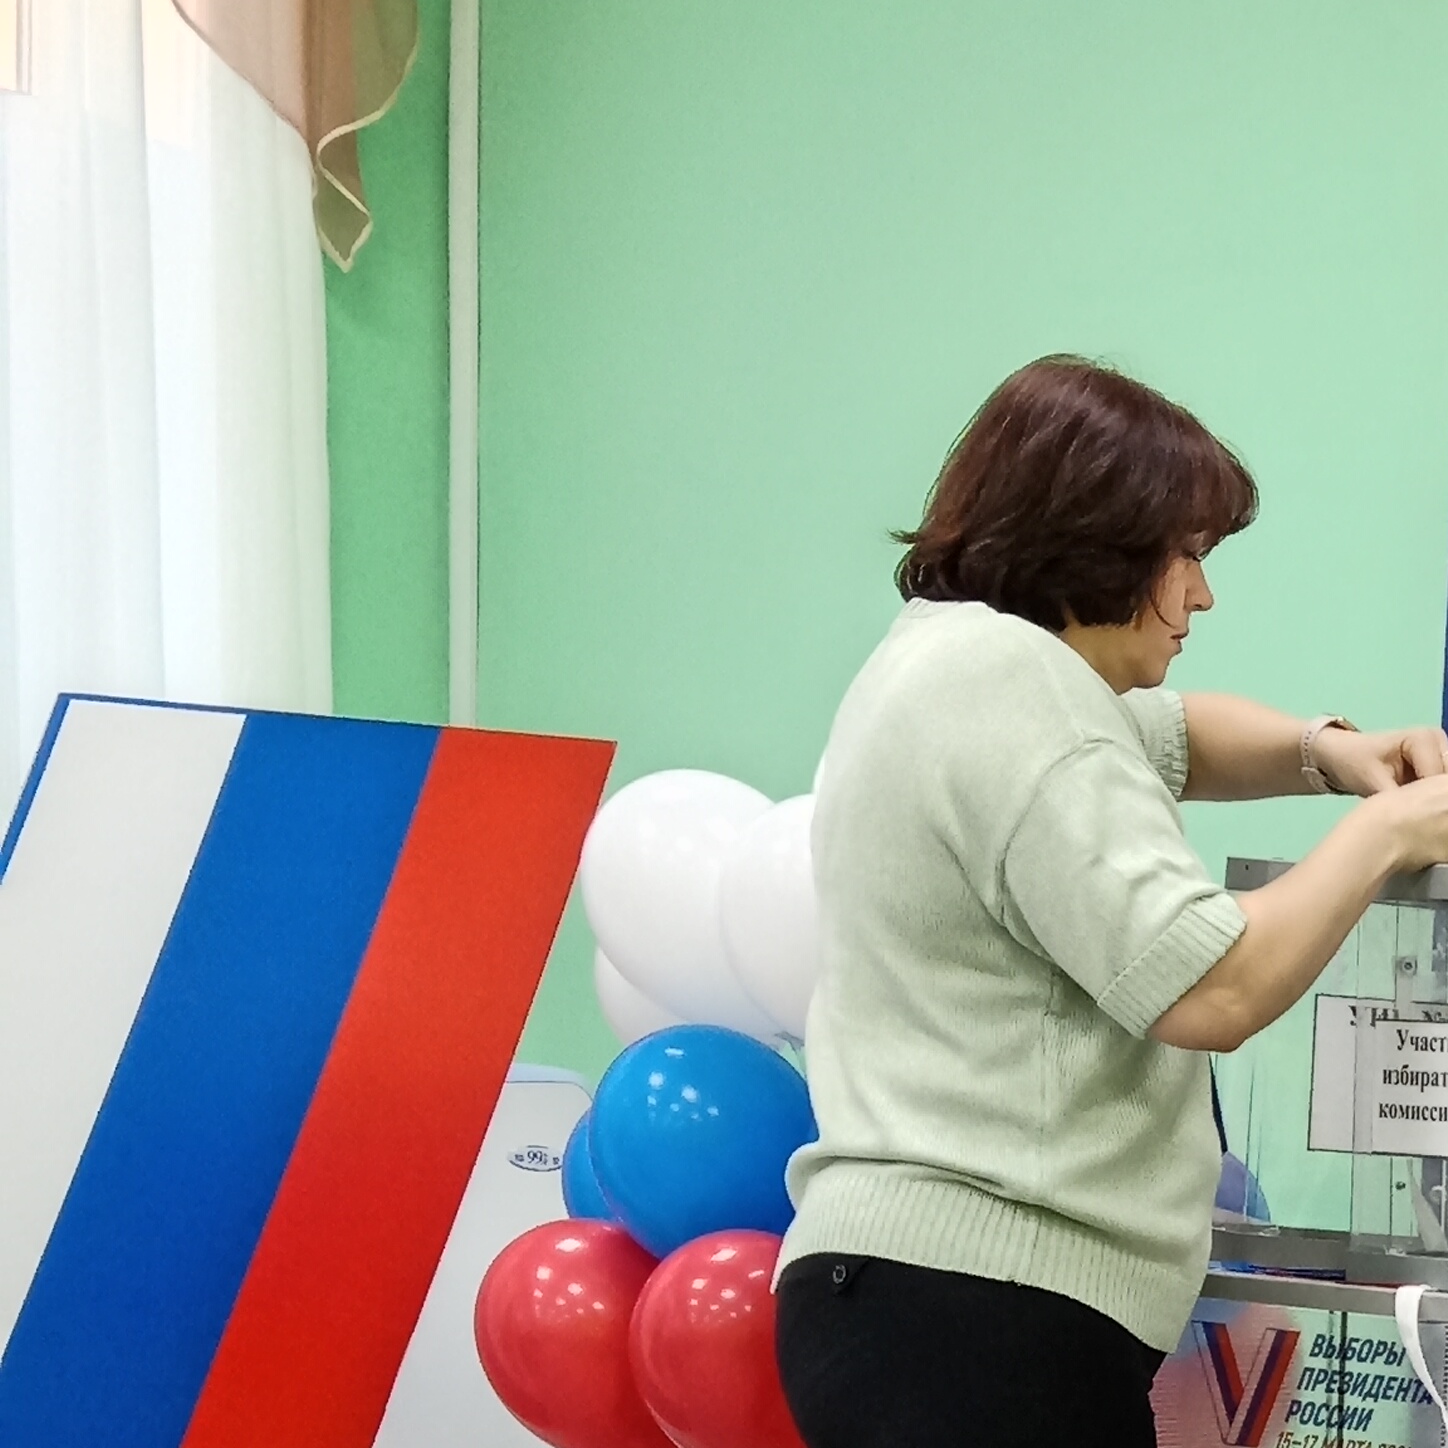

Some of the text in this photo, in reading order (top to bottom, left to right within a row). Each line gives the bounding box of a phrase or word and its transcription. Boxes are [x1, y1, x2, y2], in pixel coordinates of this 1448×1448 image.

[1309, 1333, 1407, 1367] ВЫБОРЫ
[1297, 1366, 1434, 1405] ПРЕЗИДЕНТА
[1285, 1400, 1374, 1431] РОССИИ
